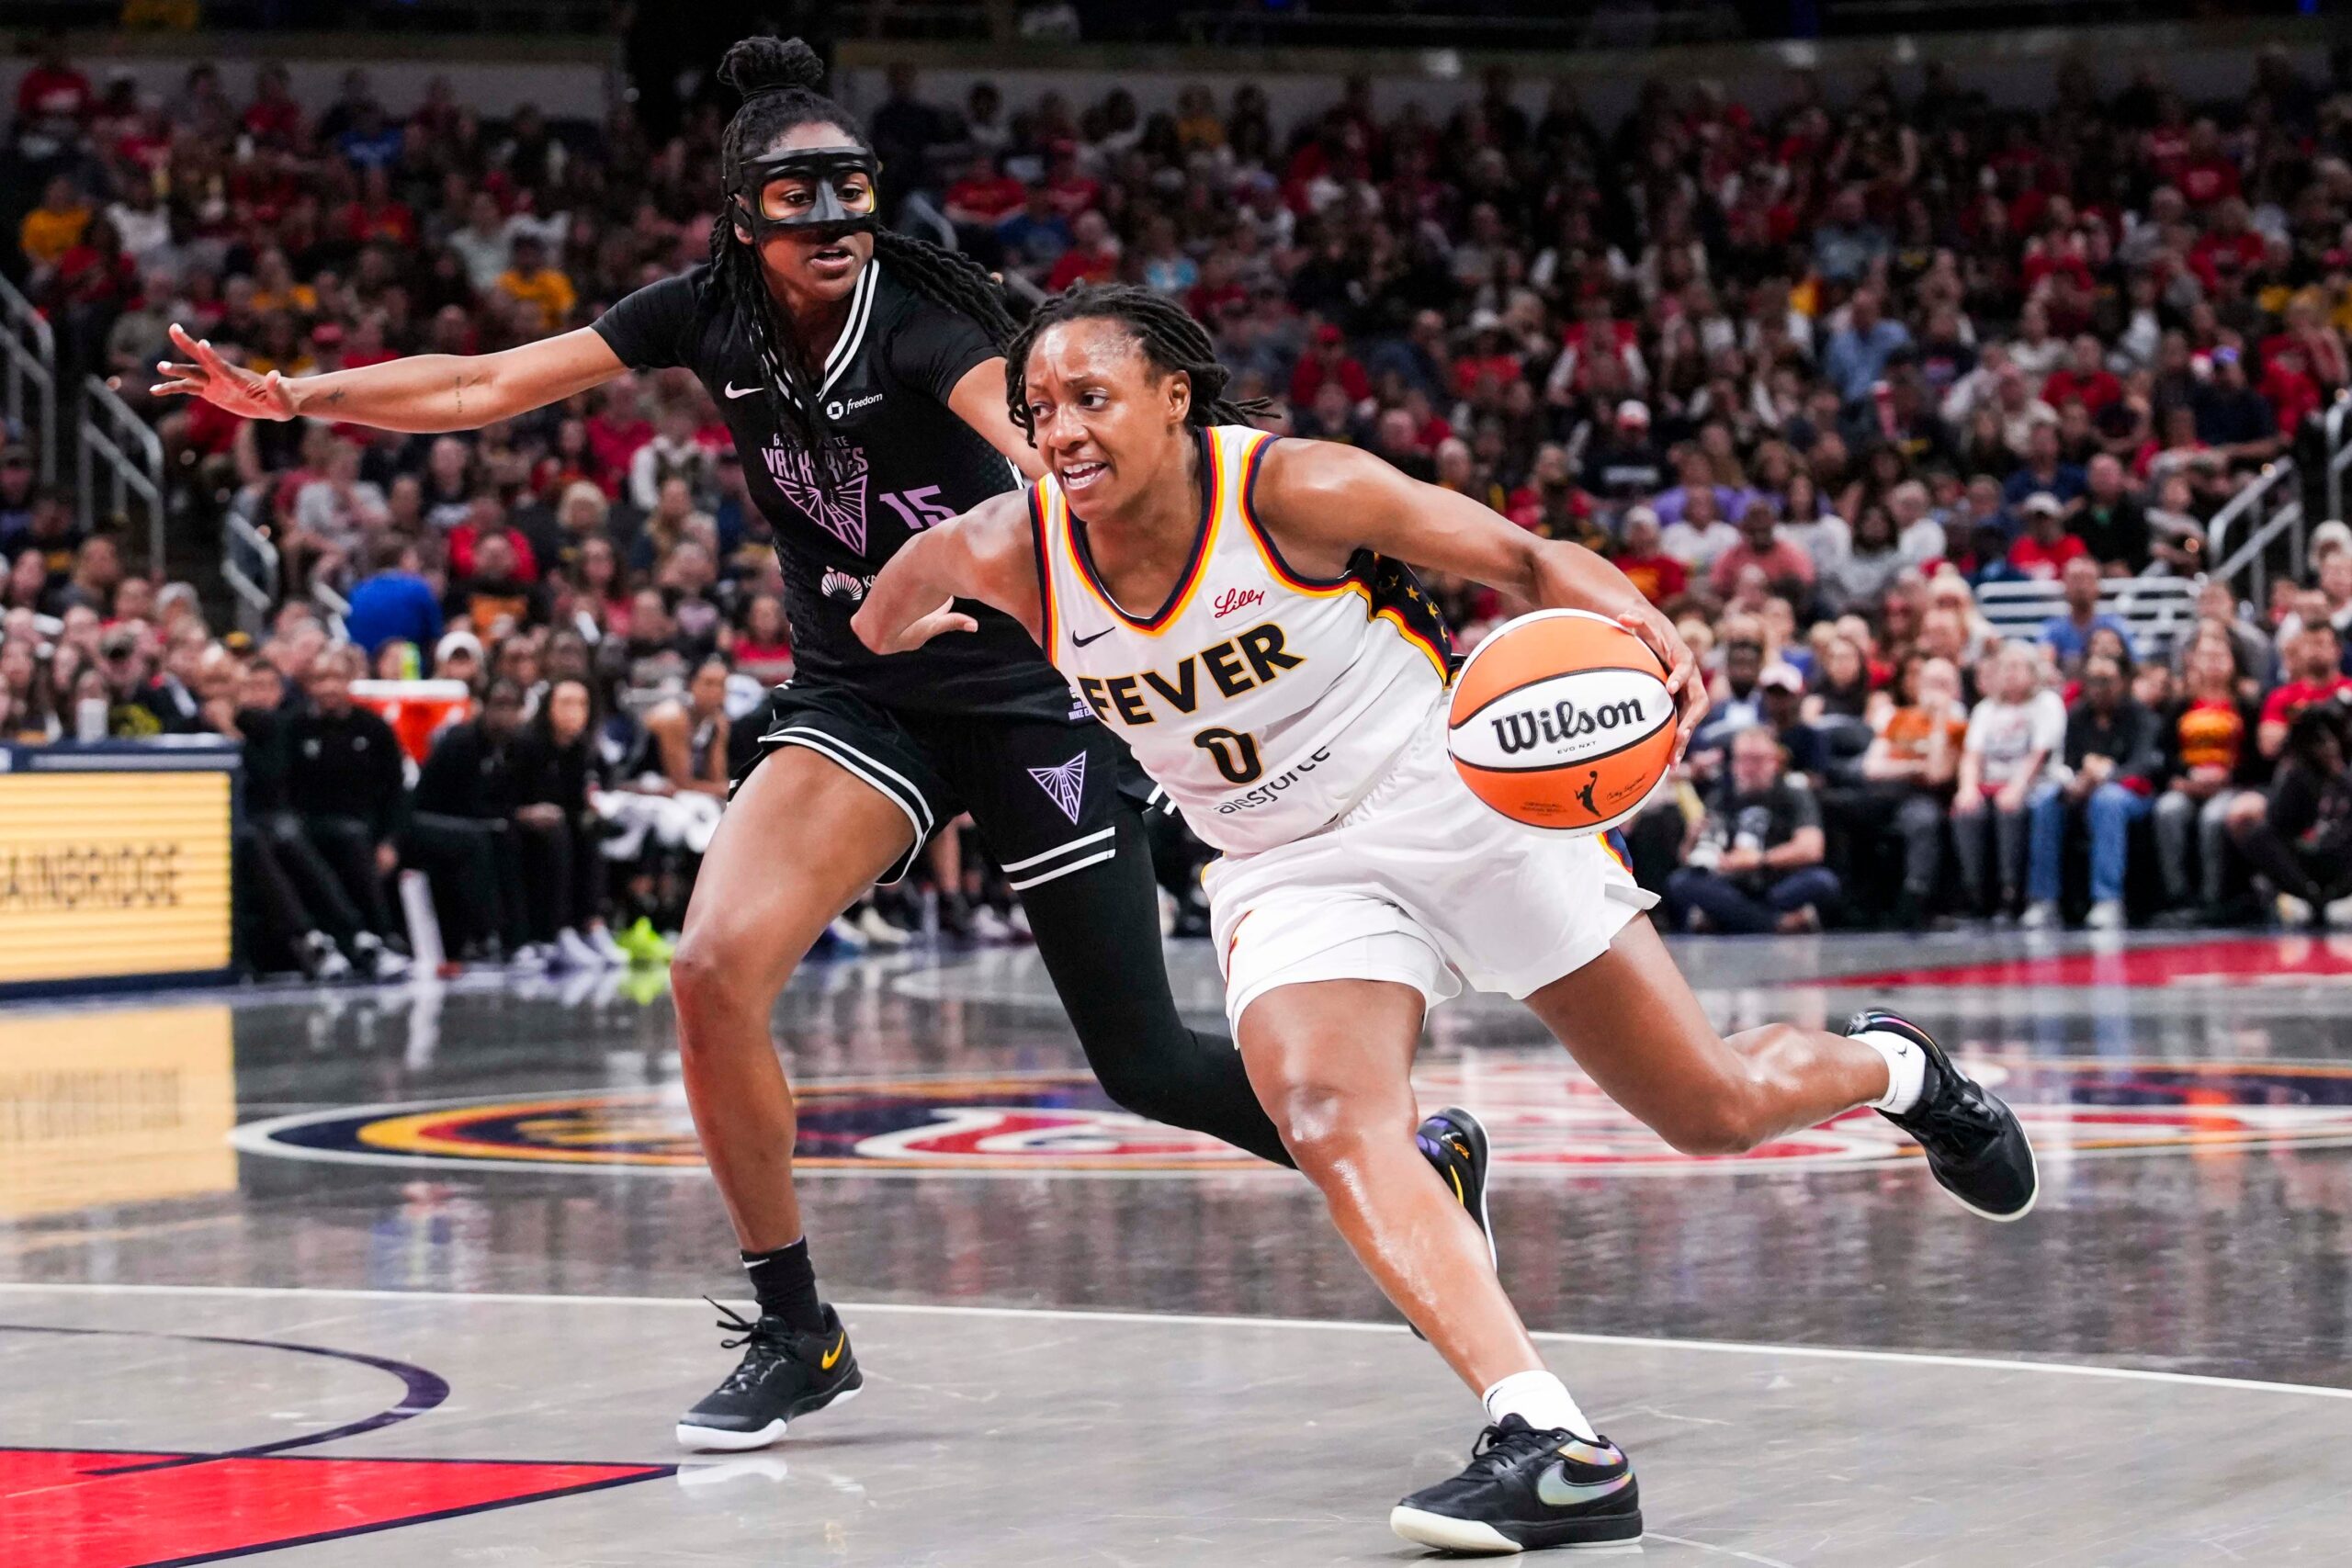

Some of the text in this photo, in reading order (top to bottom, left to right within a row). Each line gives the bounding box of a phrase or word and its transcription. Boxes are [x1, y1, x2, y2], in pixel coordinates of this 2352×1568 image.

[846, 393, 883, 414] freedom
[879, 484, 957, 529] 15
[1214, 588, 1265, 618] Lilly
[1077, 622, 1308, 726] FEVER
[1491, 698, 1645, 755] Wilson
[1557, 740, 1597, 755] EVO NXT
[1193, 726, 1266, 784] 0
